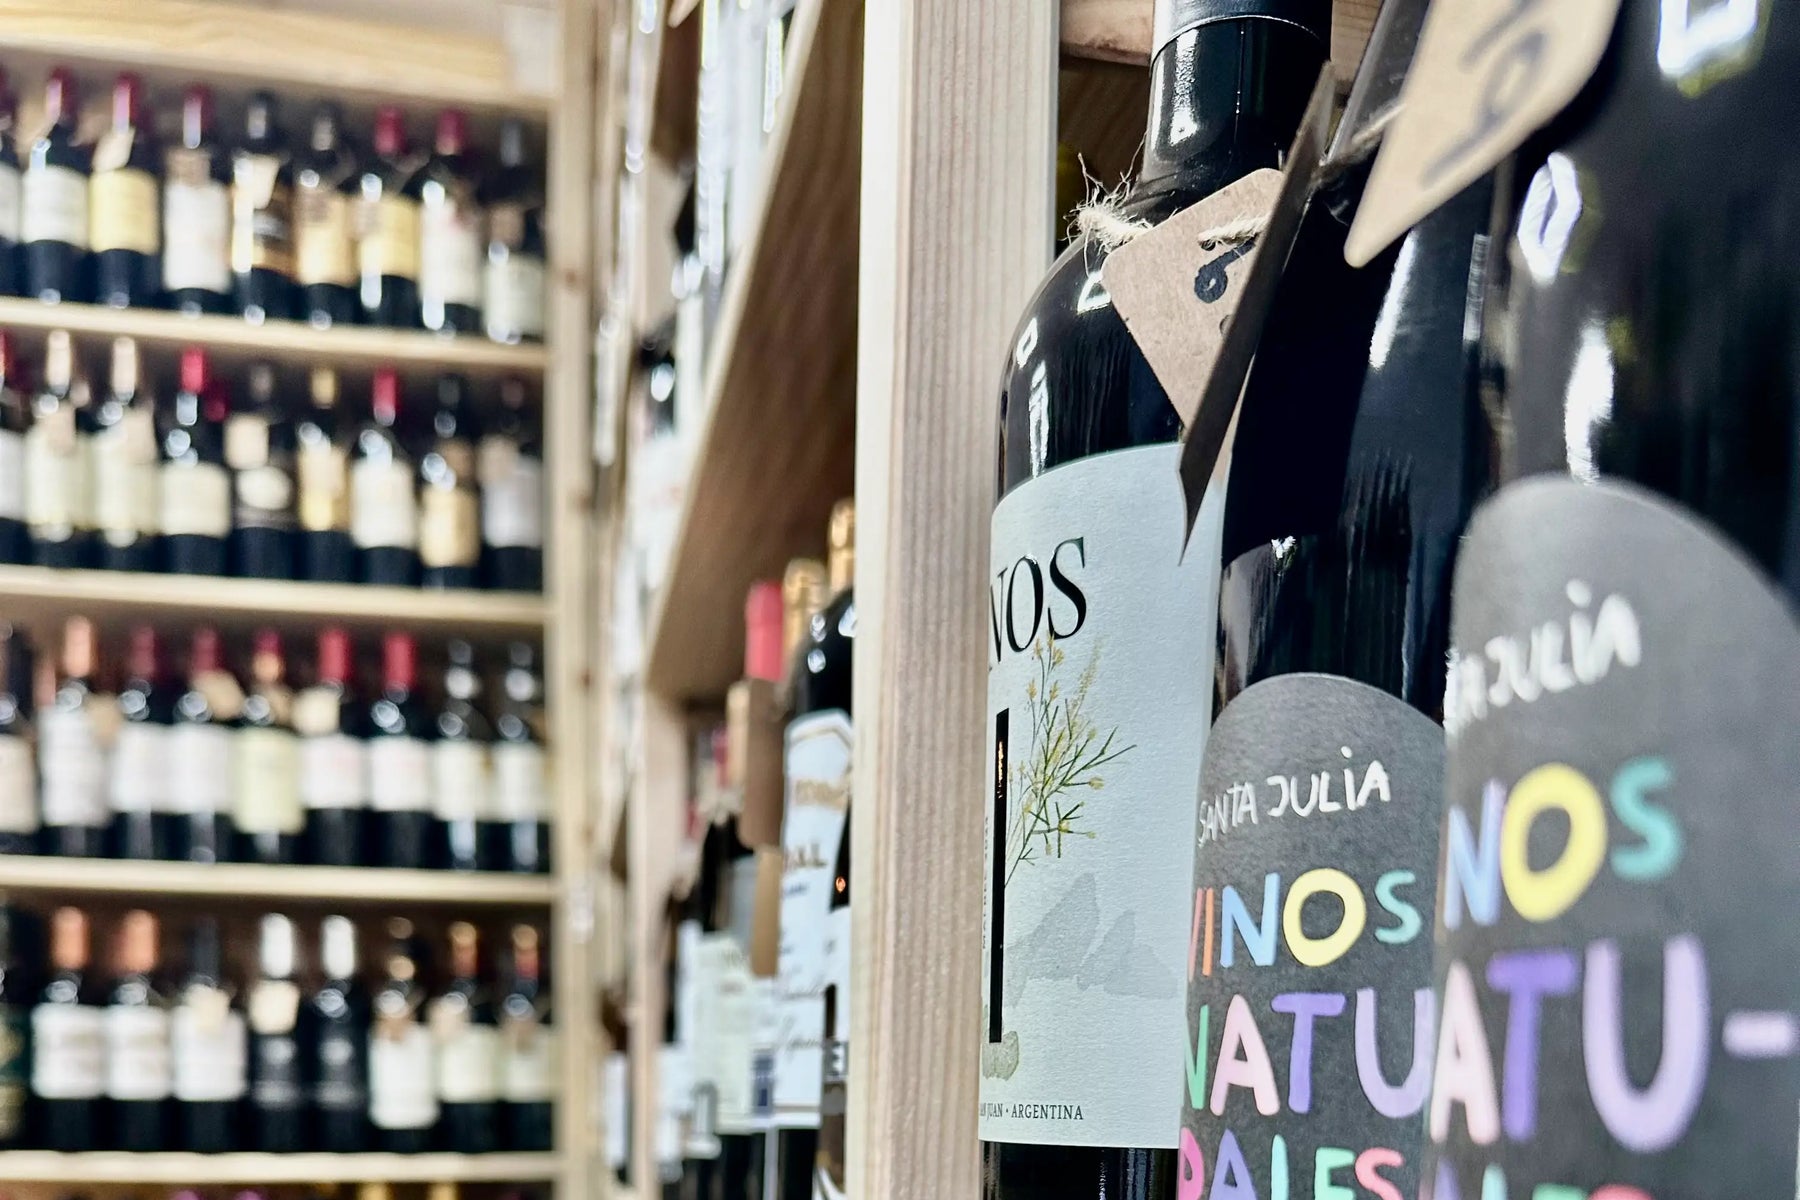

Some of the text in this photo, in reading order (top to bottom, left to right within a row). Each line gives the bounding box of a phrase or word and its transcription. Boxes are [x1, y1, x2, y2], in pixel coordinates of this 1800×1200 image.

[1198, 780, 1258, 847] SANTA
[1429, 935, 1799, 1153] ATU-
[1011, 1104, 1083, 1120] ARGENTINA
